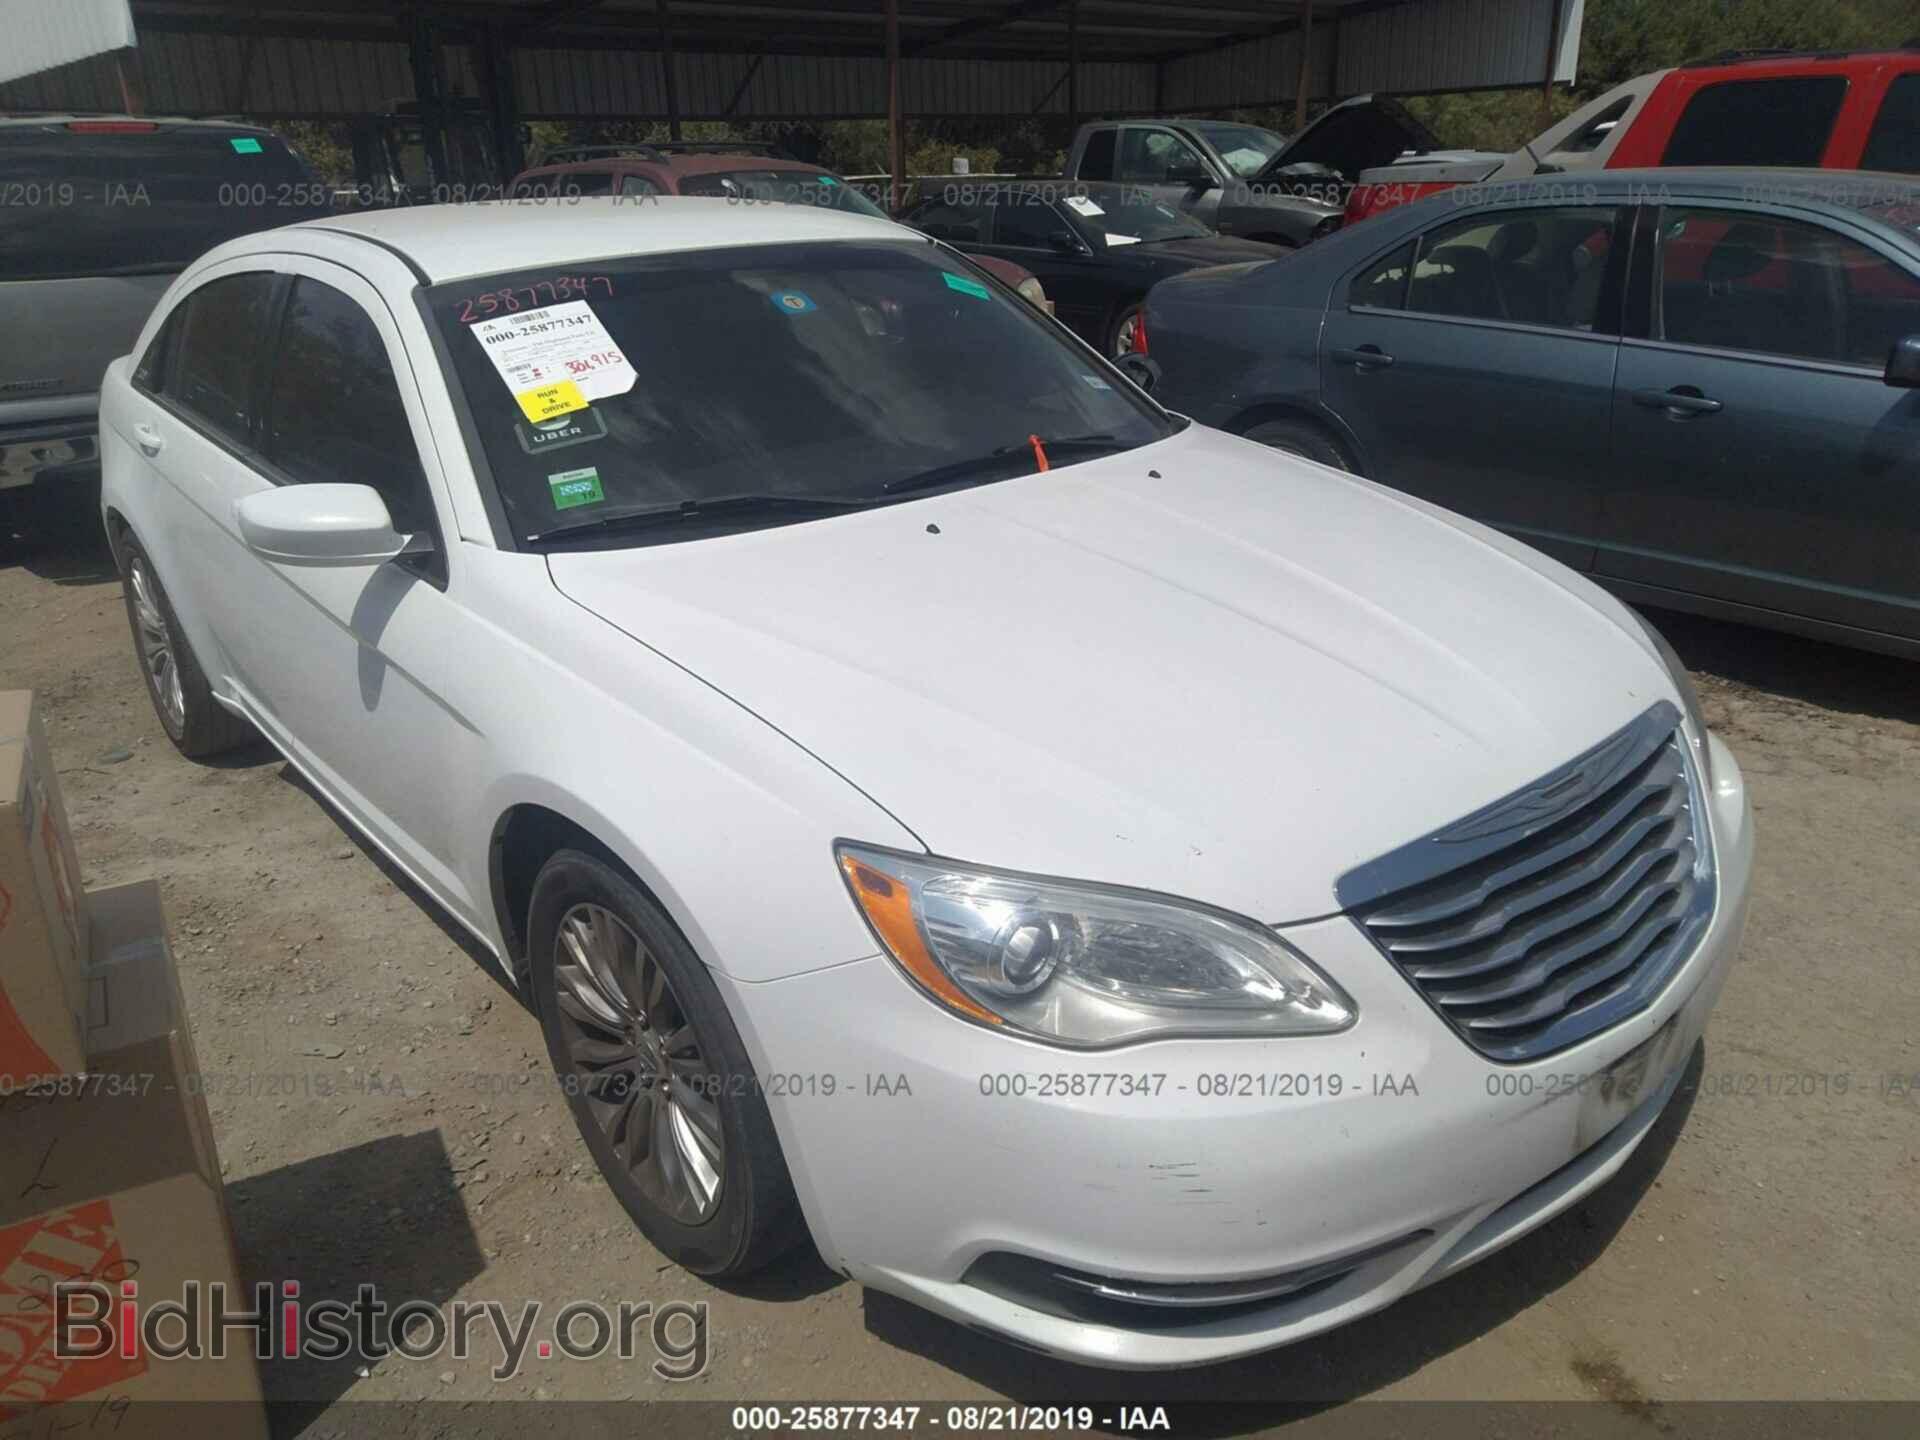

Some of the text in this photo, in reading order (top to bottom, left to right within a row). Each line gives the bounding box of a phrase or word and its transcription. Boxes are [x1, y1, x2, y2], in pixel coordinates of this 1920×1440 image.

[456, 276, 614, 322] 25877347
[485, 314, 592, 345] 000-25877347
[537, 388, 559, 400] RUN
[541, 401, 572, 415] DRIVE
[533, 427, 582, 443] UBER
